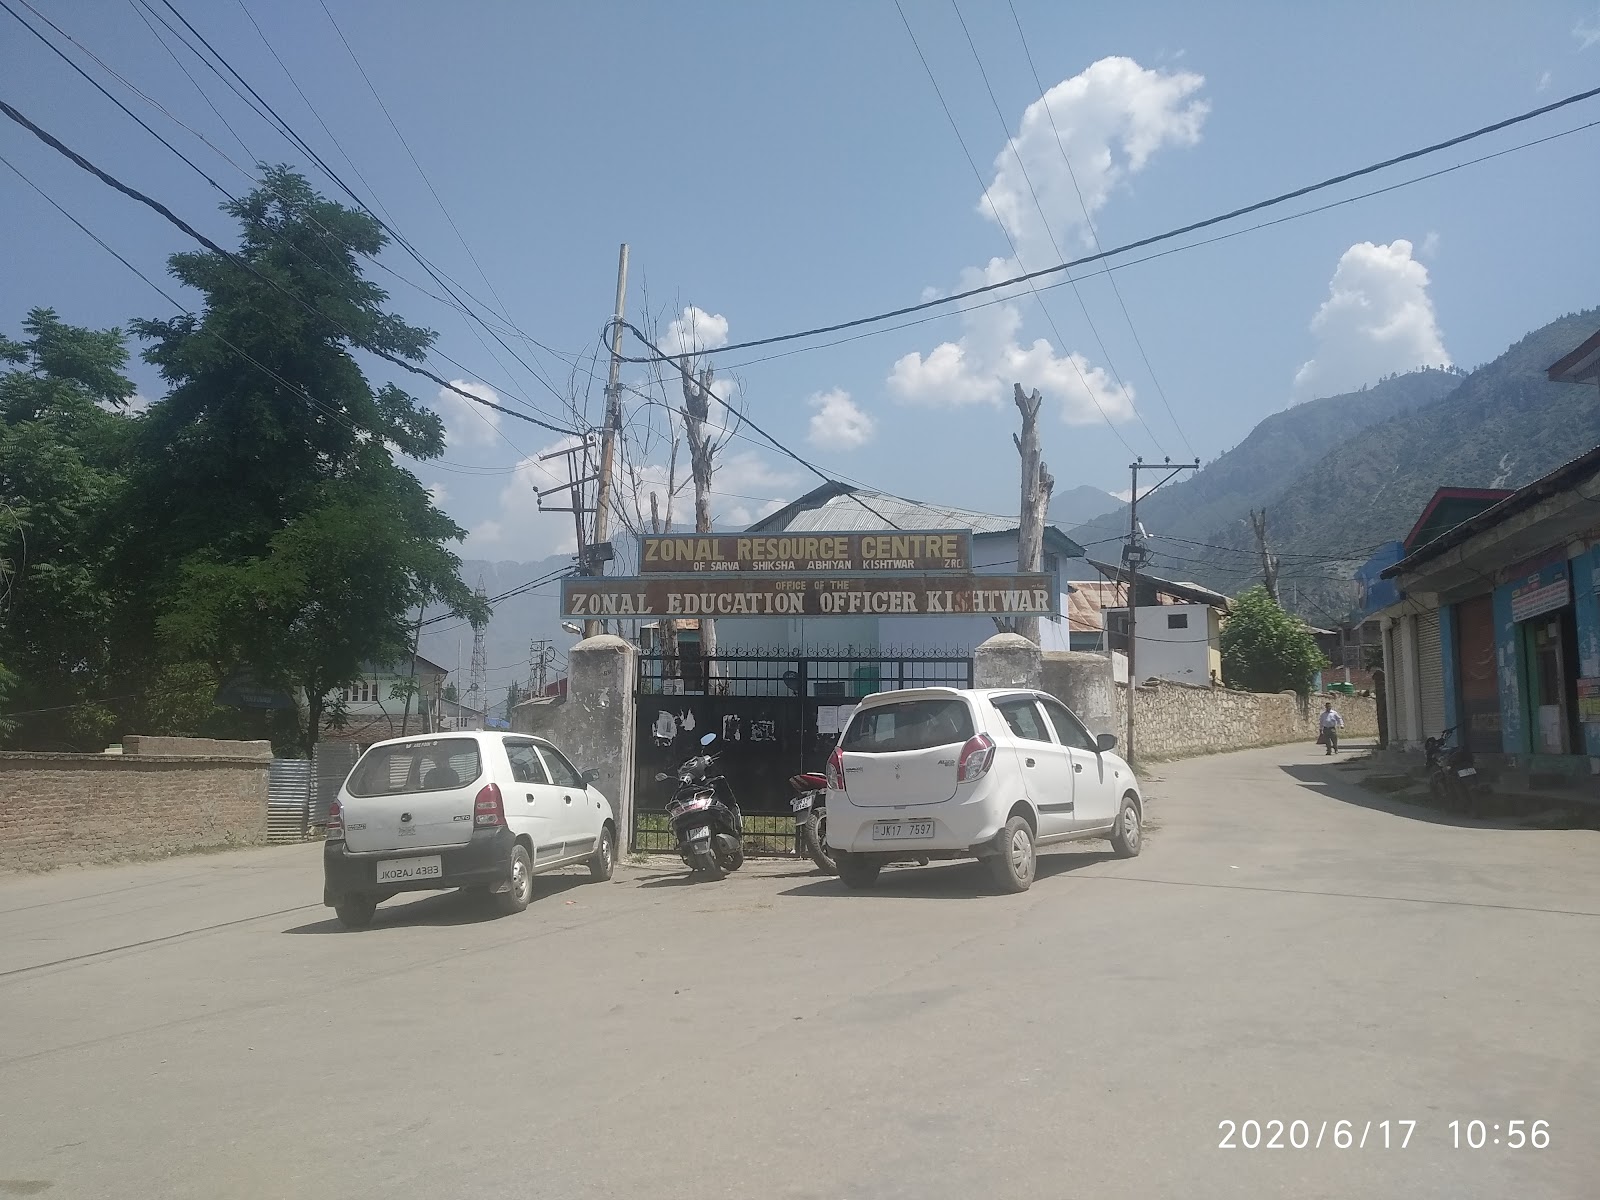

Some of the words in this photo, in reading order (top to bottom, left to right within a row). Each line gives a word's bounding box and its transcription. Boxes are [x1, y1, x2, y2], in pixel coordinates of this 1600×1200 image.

[645, 538, 724, 561] ZONAL
[737, 536, 849, 560] RESOURCE
[861, 535, 958, 559] CENTRE
[693, 561, 705, 571] OF
[710, 561, 740, 571] SARVA
[752, 560, 795, 571] SHIKSHA
[806, 560, 851, 570] ABHIYAN
[862, 559, 915, 569] KISHTWAR
[775, 580, 806, 590] OFFICE
[814, 580, 825, 590] OF
[830, 580, 849, 590] THE
[571, 593, 653, 615] ZONAL
[666, 592, 805, 614] EDUCATION
[819, 591, 918, 613] OFFICER
[926, 589, 1050, 612] KISHTWAR
[881, 825, 901, 836] JK17
[909, 824, 931, 836] 7597
[380, 868, 413, 880] JK02AJ
[415, 865, 439, 876] 4383
